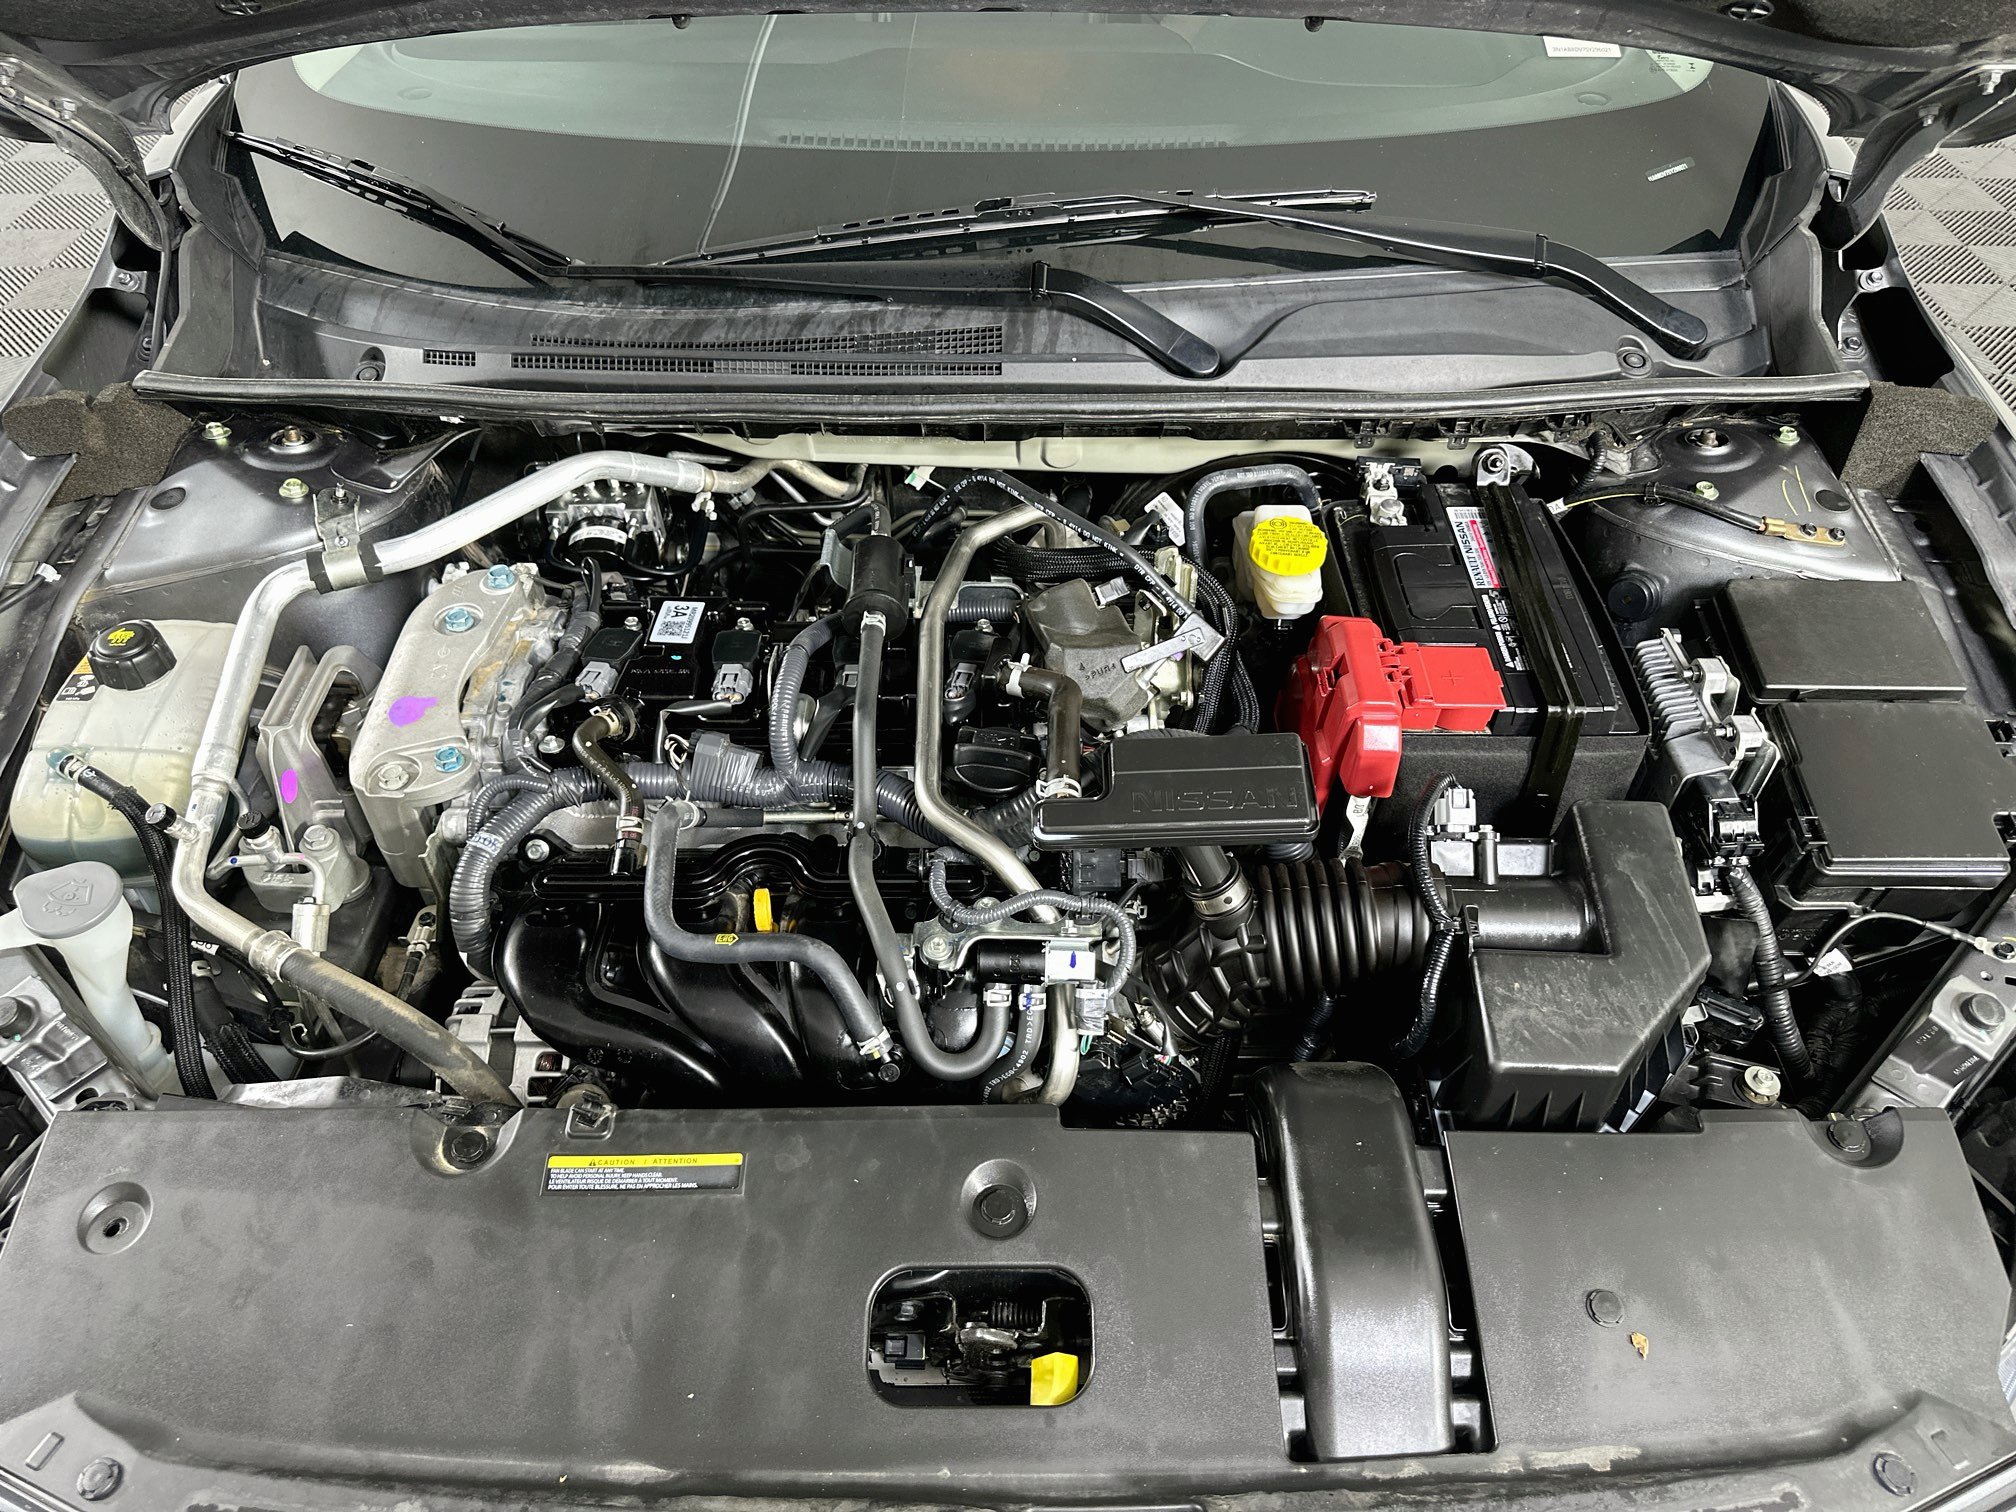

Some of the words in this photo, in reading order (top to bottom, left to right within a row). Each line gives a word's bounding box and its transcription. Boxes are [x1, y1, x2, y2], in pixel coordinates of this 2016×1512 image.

[1092, 534, 1103, 545] NOT
[1103, 541, 1119, 555] KINK
[1454, 521, 1473, 554] NISSAN
[1466, 554, 1486, 587] RENAULT
[671, 605, 690, 618] 3A
[1131, 788, 1298, 813] NISSAN
